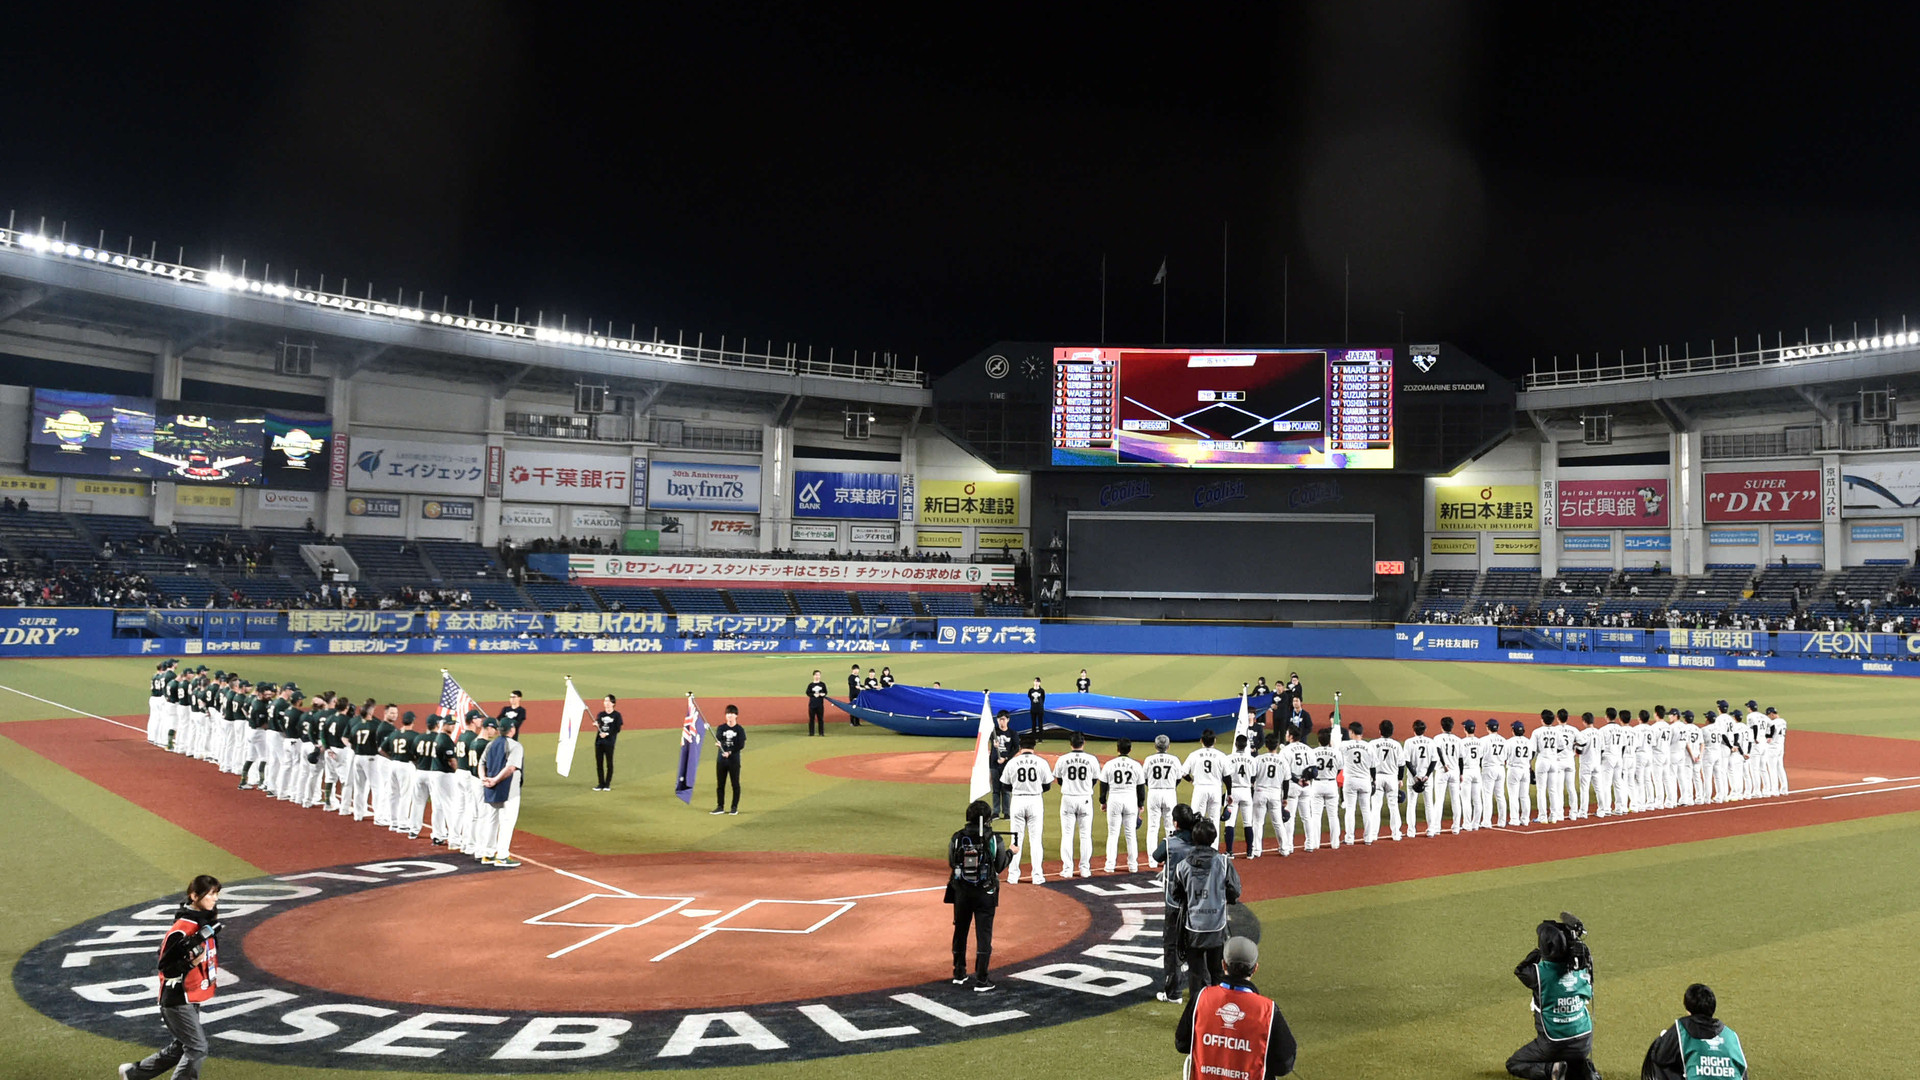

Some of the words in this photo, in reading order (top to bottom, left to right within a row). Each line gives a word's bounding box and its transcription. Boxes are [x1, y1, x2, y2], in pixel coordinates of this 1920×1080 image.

[1346, 352, 1375, 360] JAPAN
[388, 463, 482, 480] エイジェック
[691, 472, 739, 480] Anniversary
[532, 467, 626, 490] 千葉銀行
[1744, 480, 1786, 489] SUPER
[668, 479, 743, 501] bayfm78
[1100, 479, 1152, 506] Coolish
[1826, 468, 1836, 505] 京成バス
[834, 488, 897, 505] 京葉銀行
[1194, 479, 1246, 508] Coolish
[1544, 481, 1552, 516] 京成バス
[924, 497, 1014, 514] 新日本建設
[1440, 502, 1533, 519] 新日本建設
[1560, 498, 1636, 517] ちば興銀
[514, 516, 552, 524] KAKUTA
[584, 518, 620, 527] KAKUTA
[710, 520, 752, 532] サビキラー
[625, 561, 707, 574] セブン-イレブン
[856, 567, 962, 580] チケットのお求めは
[18, 617, 57, 626] SUPER
[247, 617, 278, 625] FREE
[288, 612, 414, 632] 新東京グループ
[445, 613, 544, 631] 金太郎ホーム
[554, 612, 665, 633] 東進ハイスクール
[676, 615, 786, 632] 東京インテリア
[961, 632, 1036, 644] トラバース
[1428, 638, 1479, 649] 三井住友銀行
[1692, 631, 1752, 649] 新昭和
[329, 639, 409, 652] 新東京グループ
[479, 640, 538, 651] 金太郎ホーム
[592, 639, 662, 651] 東進ハイスクール
[712, 640, 778, 651] 東京インテリア
[836, 640, 890, 651] アインズホーム
[1681, 656, 1715, 666] 新昭和
[329, 722, 336, 736] 4
[1661, 730, 1670, 741] 47
[356, 730, 370, 744] 17
[1544, 737, 1556, 748] 22
[1612, 734, 1621, 745] 17
[1691, 732, 1699, 743] 57
[393, 739, 407, 754] 12
[1418, 746, 1426, 758] 2
[1445, 743, 1455, 756] 11
[1470, 747, 1477, 758] 5
[1492, 744, 1504, 756] 27
[1516, 746, 1528, 758] 62
[1295, 753, 1308, 766] 51
[1354, 751, 1361, 764] 3
[1382, 749, 1389, 761] 7
[1204, 760, 1212, 773] 9
[1238, 764, 1246, 777] 4
[1317, 758, 1334, 771] 34
[1018, 767, 1037, 782] 80
[1068, 766, 1087, 780] 88
[1114, 770, 1132, 784] 82
[1153, 766, 1171, 779] 87
[1268, 765, 1276, 778] 8
[1203, 1033, 1252, 1052] OFFICIAL
[1701, 1056, 1730, 1067] RIGHT
[1200, 1065, 1249, 1080] #PREMIER12
[1696, 1065, 1735, 1078] HOLDER
